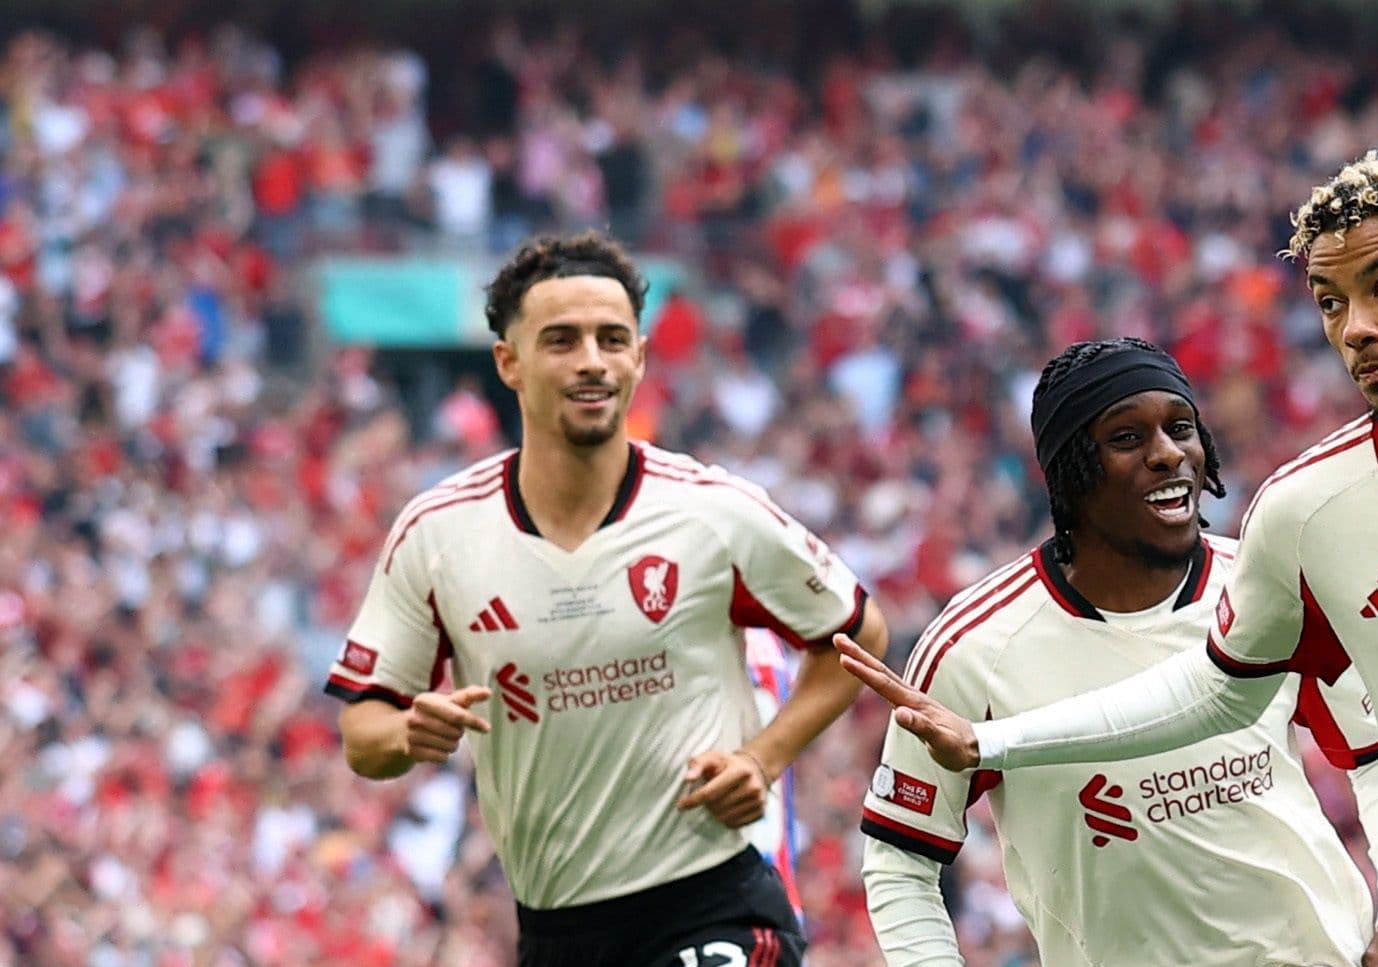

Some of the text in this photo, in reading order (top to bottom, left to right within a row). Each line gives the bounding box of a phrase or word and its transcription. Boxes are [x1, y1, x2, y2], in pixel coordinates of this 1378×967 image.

[543, 649, 667, 690] standard
[547, 670, 675, 712] chartered
[1139, 744, 1271, 799] standard
[1147, 766, 1274, 823] chartered
